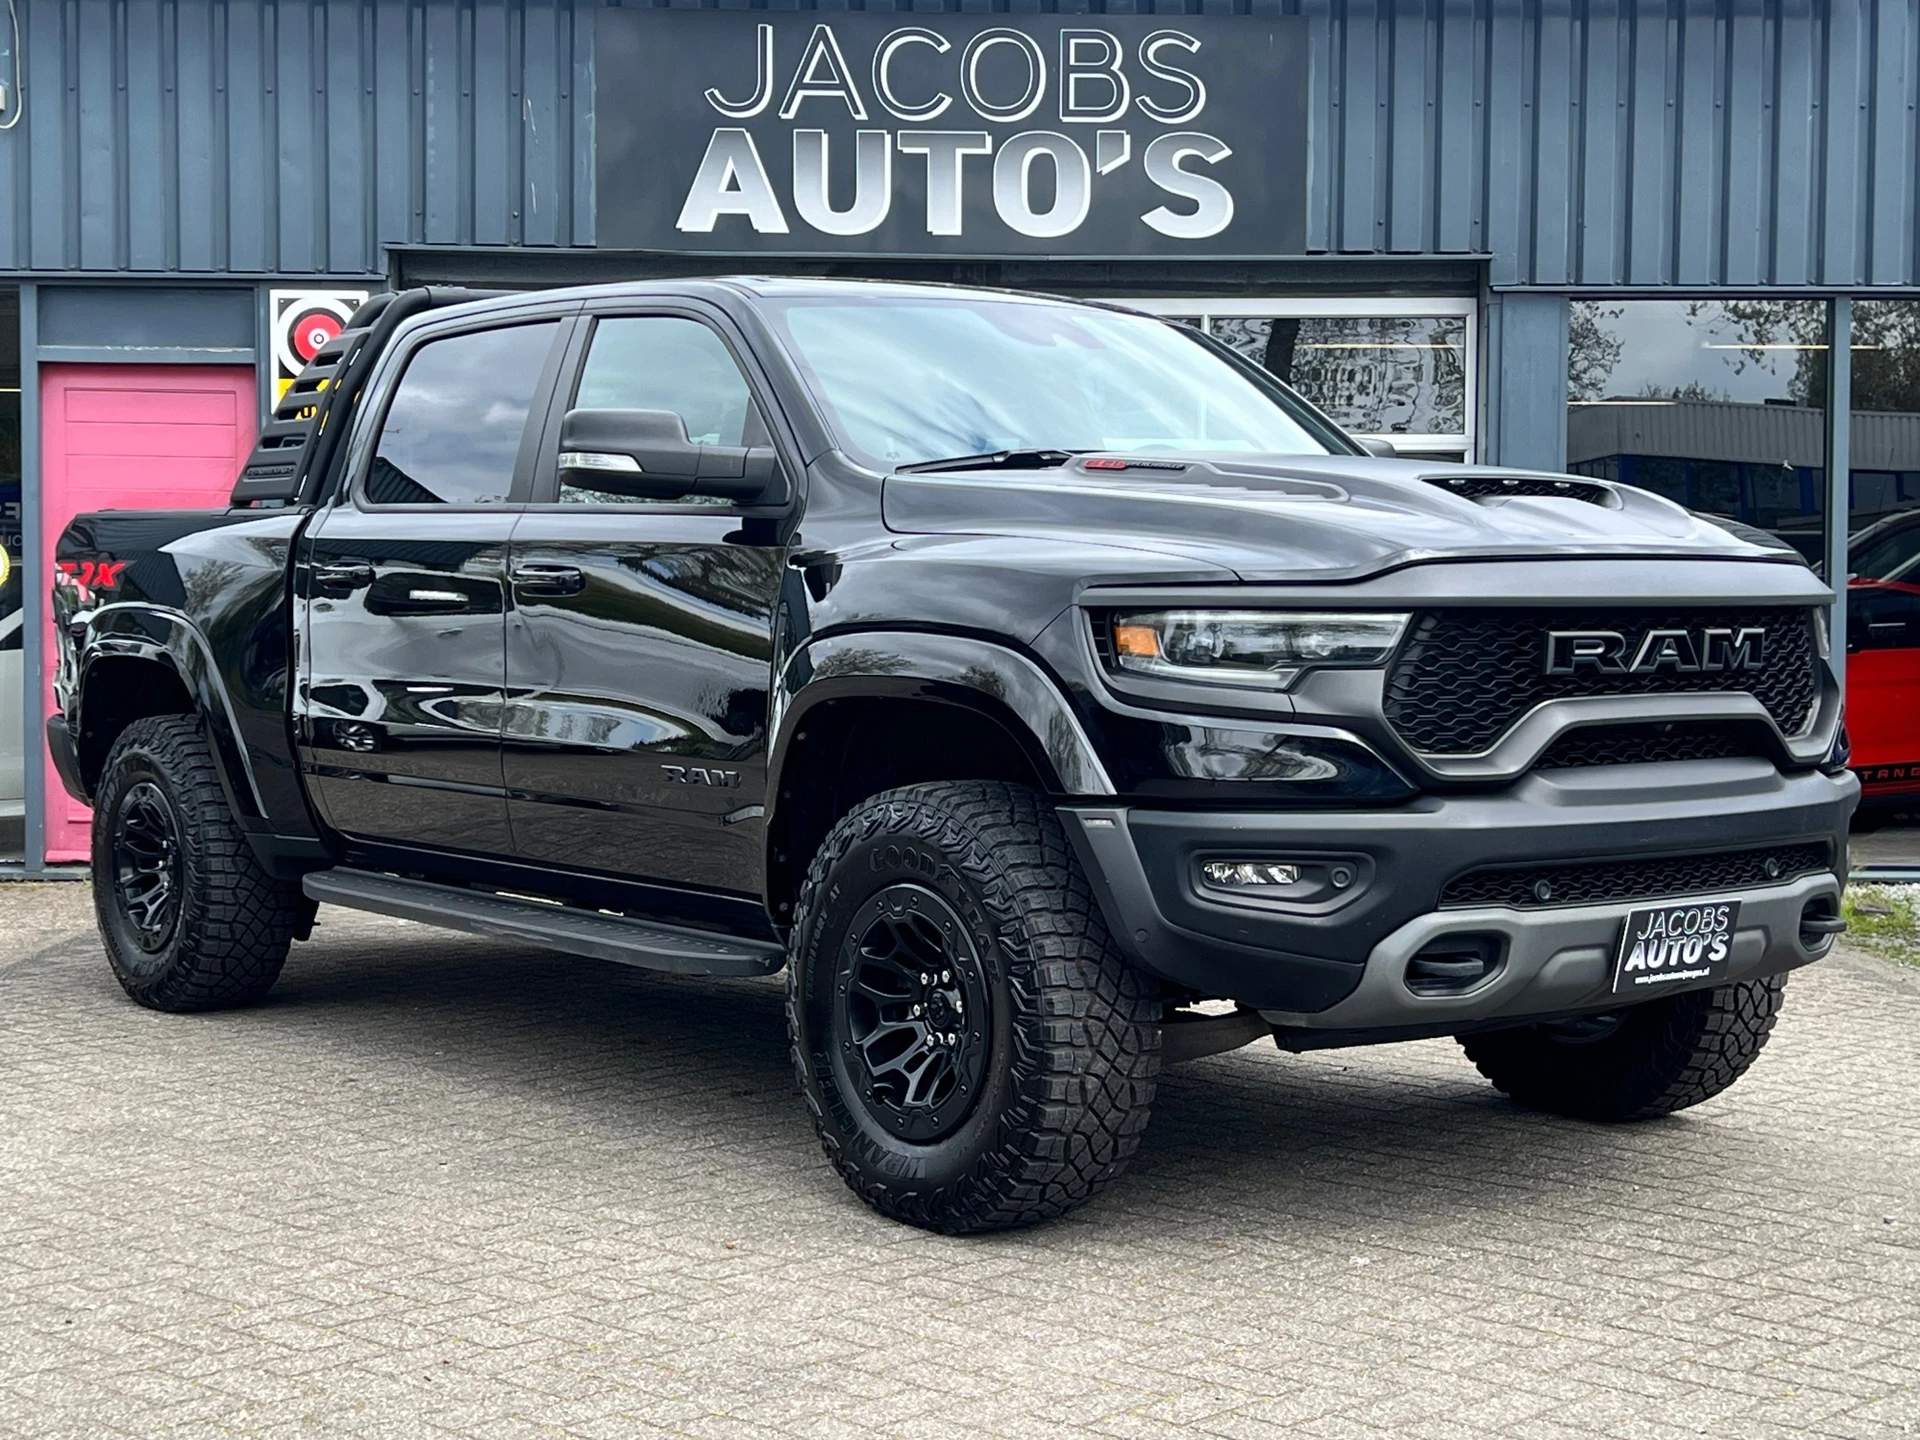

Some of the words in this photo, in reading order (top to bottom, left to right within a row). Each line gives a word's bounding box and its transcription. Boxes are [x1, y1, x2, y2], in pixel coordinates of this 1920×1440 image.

[704, 23, 1206, 124] JACOBS
[675, 127, 1235, 239] AUTO'S
[1546, 628, 1765, 674] RAM
[660, 764, 742, 789] RAM
[1637, 905, 1730, 940] JACOBS
[1624, 931, 1730, 972] AUTO'S
